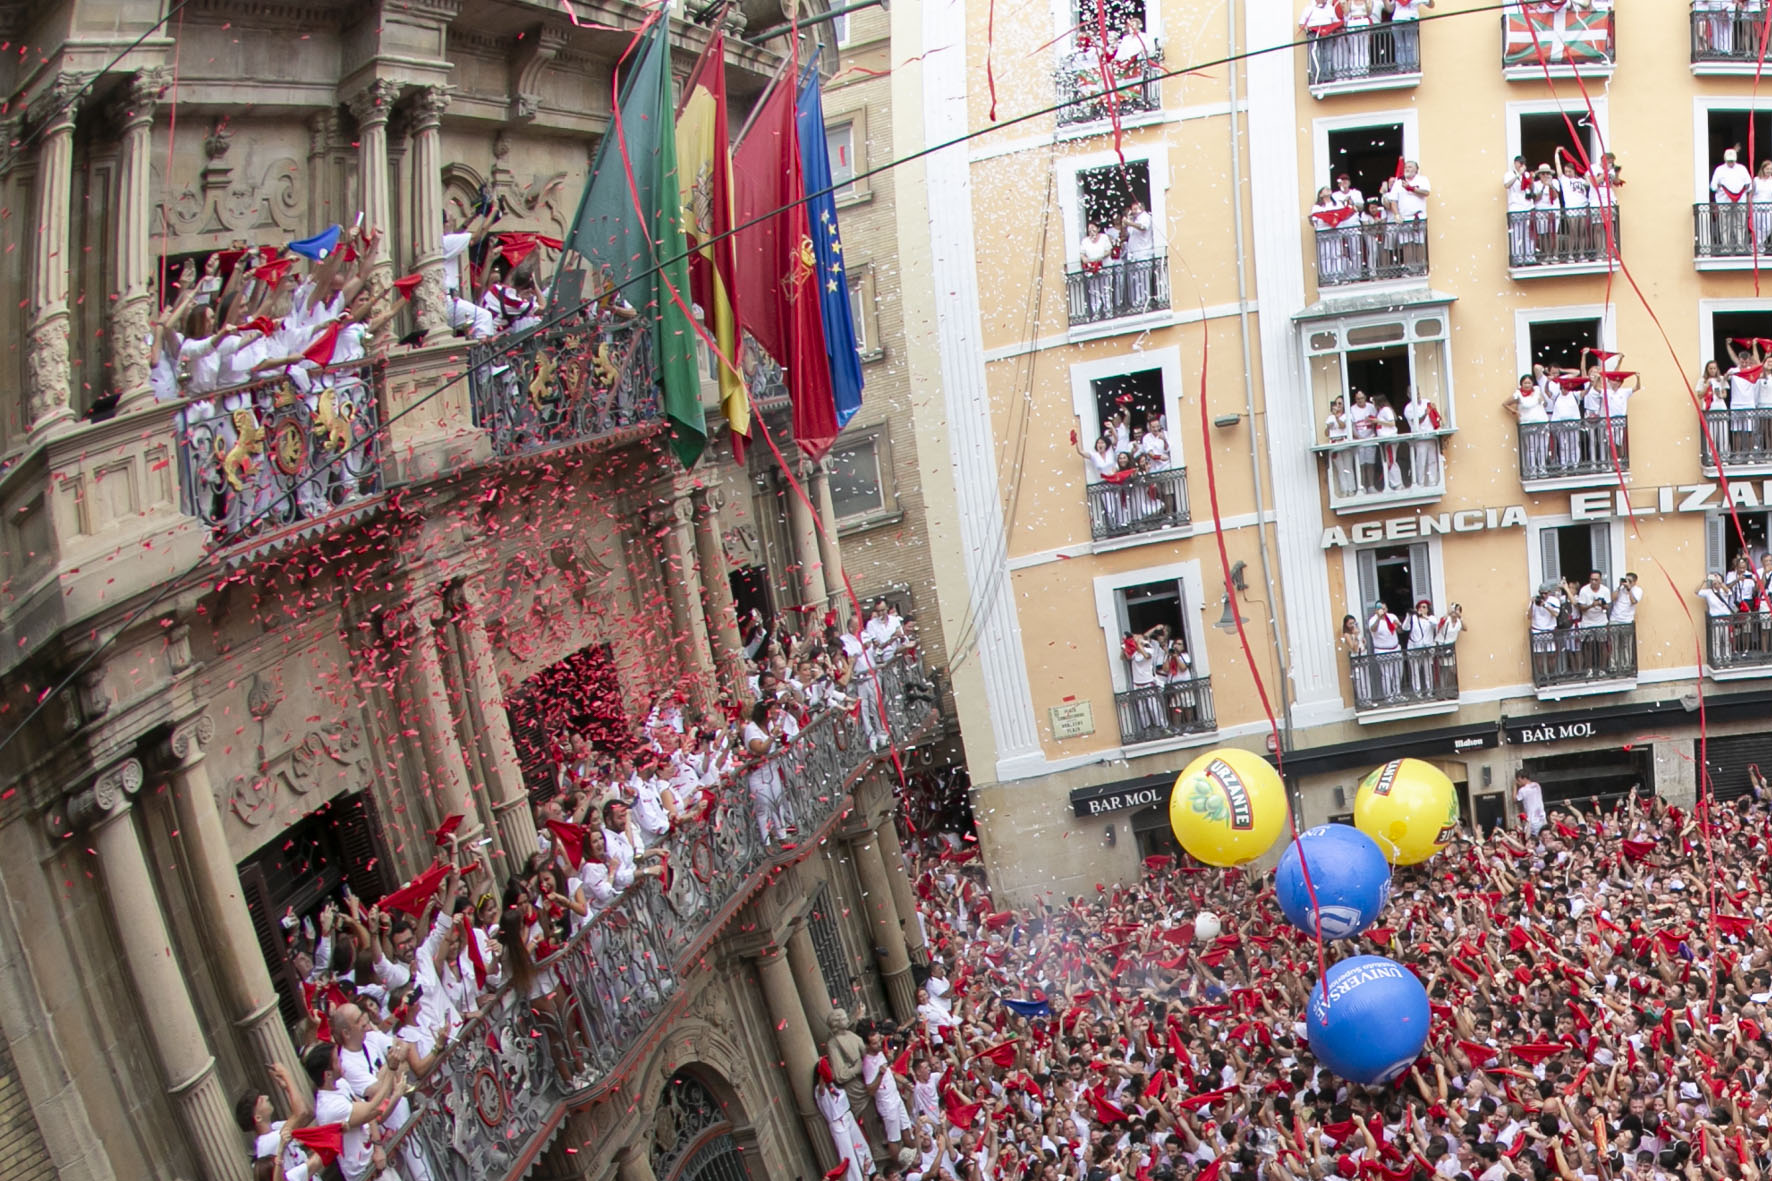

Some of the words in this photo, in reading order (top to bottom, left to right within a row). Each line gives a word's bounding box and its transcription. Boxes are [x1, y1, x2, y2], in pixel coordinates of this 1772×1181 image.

[1320, 505, 1528, 548] AGENCIA
[1522, 725, 1557, 743] BAR
[1558, 721, 1597, 739] MOL
[1088, 796, 1123, 813] BAR
[1124, 789, 1162, 807] MOL
[1210, 761, 1249, 825] URZANTE
[1316, 966, 1403, 1021] UNIVERSAE
